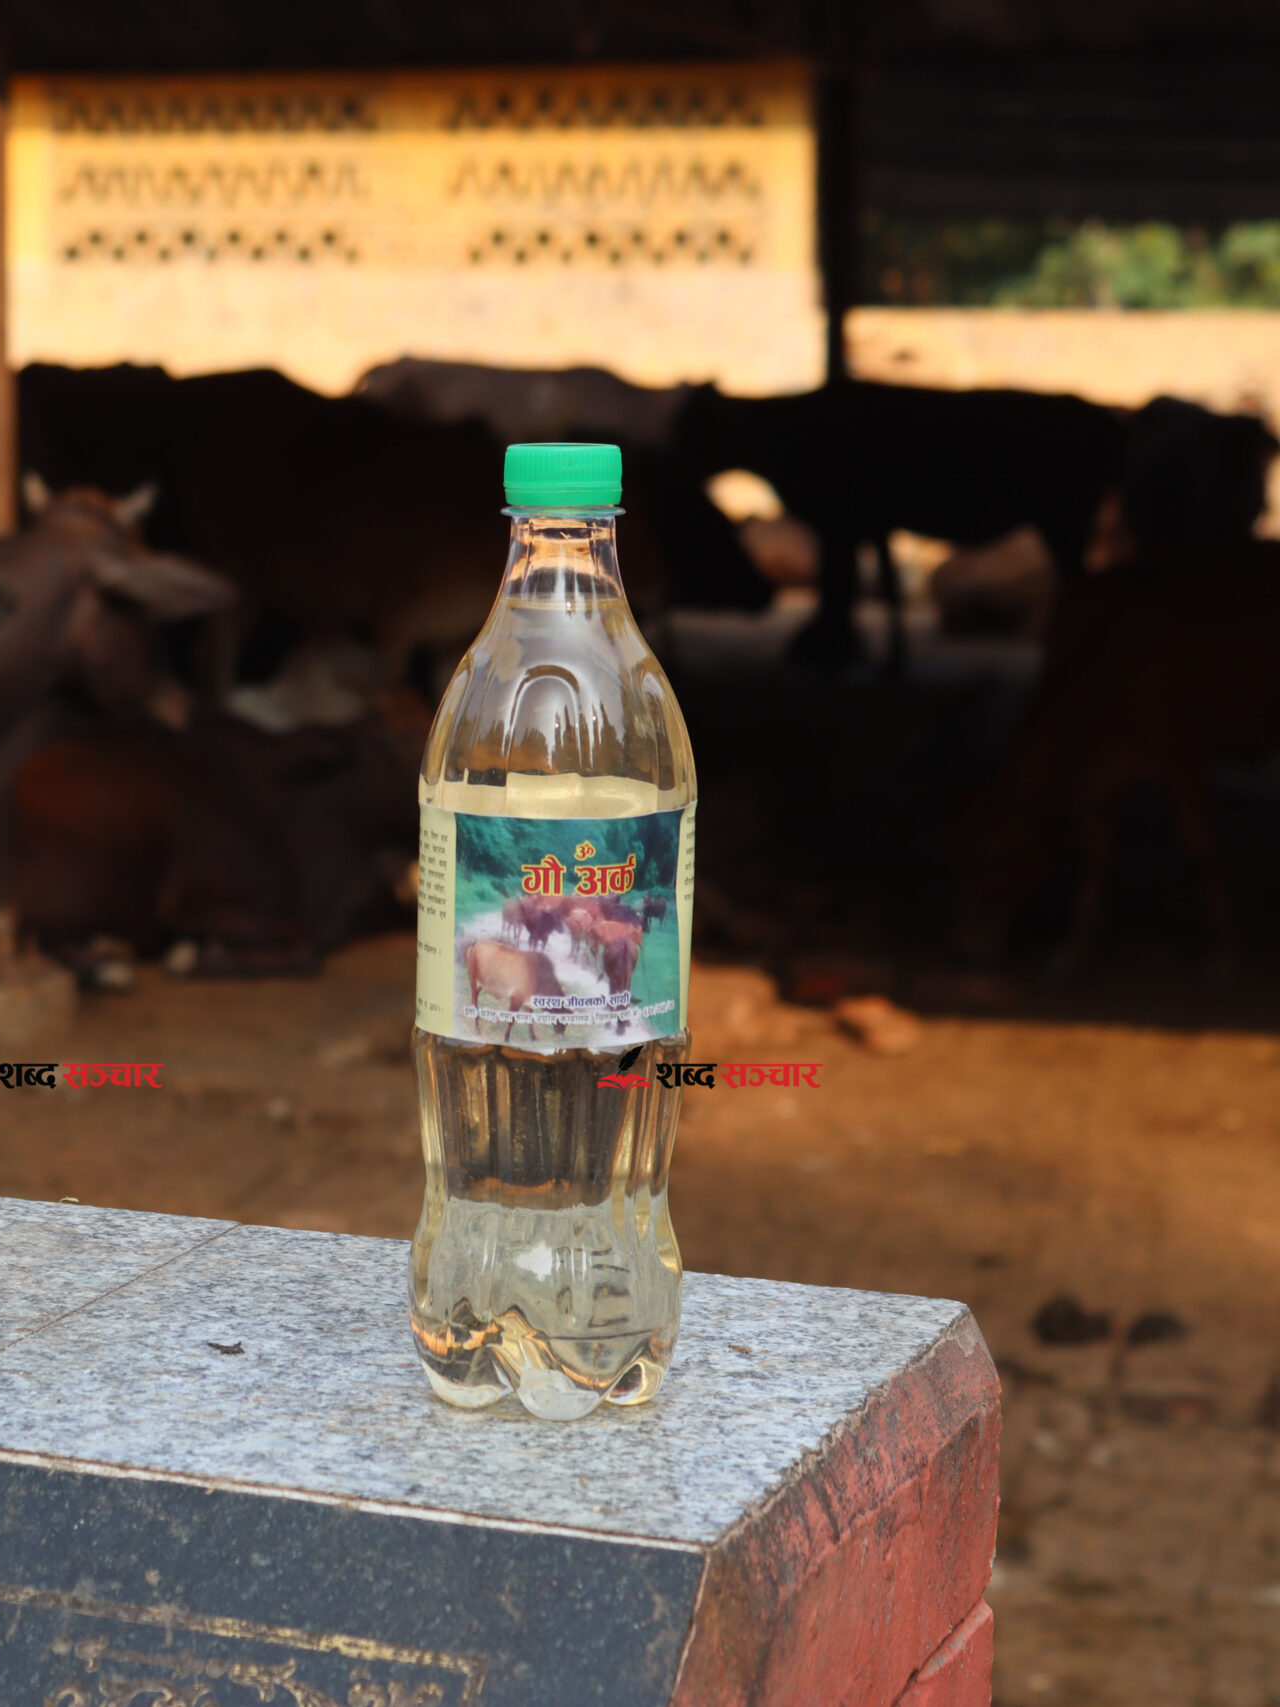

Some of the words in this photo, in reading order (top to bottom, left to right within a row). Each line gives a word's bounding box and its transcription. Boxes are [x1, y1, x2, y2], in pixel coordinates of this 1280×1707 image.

[575, 841, 596, 860] ॐ
[522, 854, 566, 896] गौ
[575, 853, 636, 896] अर्क
[565, 994, 606, 1007] जीवनको
